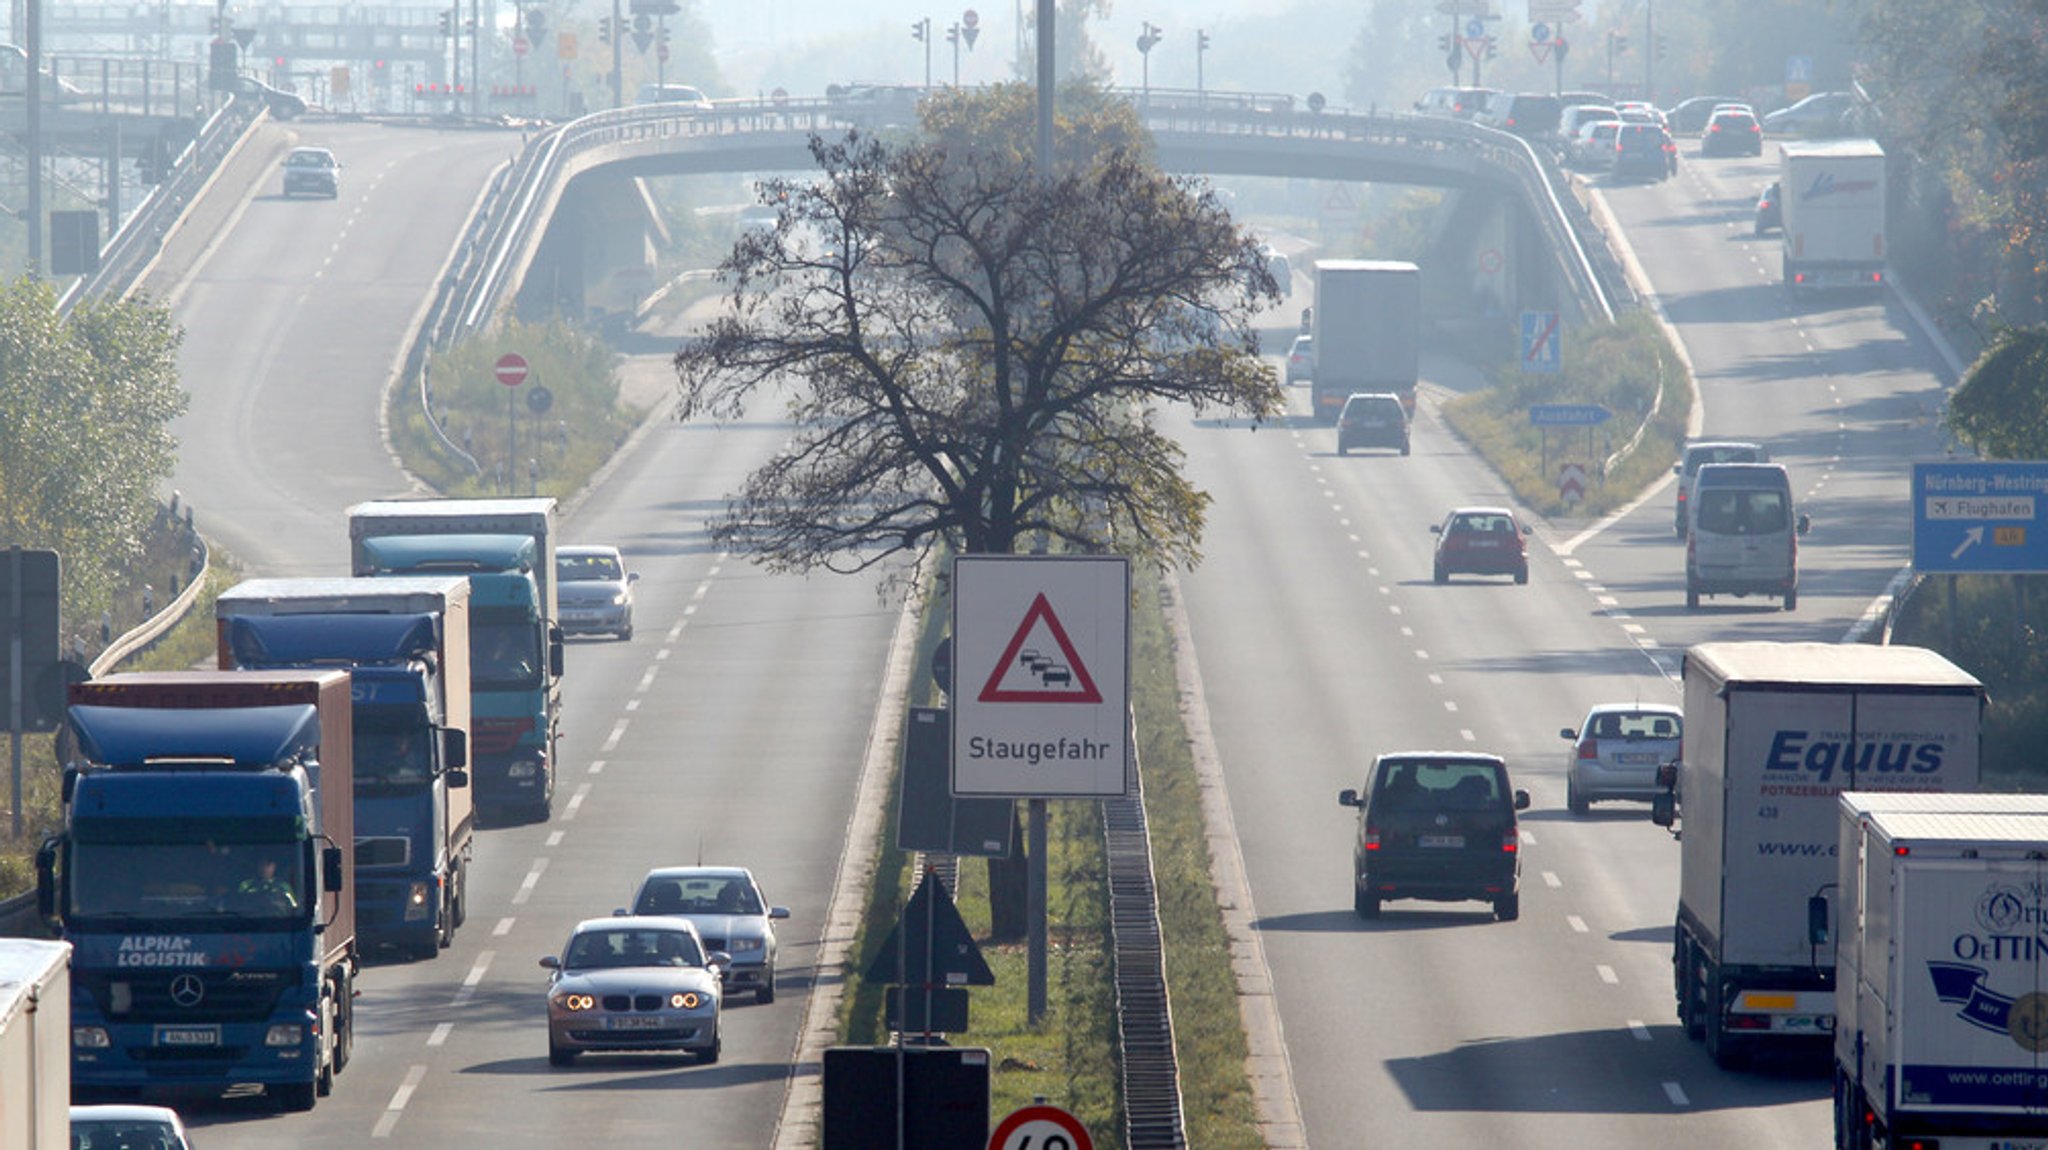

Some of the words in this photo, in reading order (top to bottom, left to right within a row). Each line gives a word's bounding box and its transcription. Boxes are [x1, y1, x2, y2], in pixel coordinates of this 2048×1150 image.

[1958, 502, 2031, 517] Flughafen
[969, 736, 1110, 765] Staugefahr
[1765, 731, 1944, 782] Equus
[120, 936, 184, 951] ALPHA
[117, 952, 206, 967] LOGISTIK
